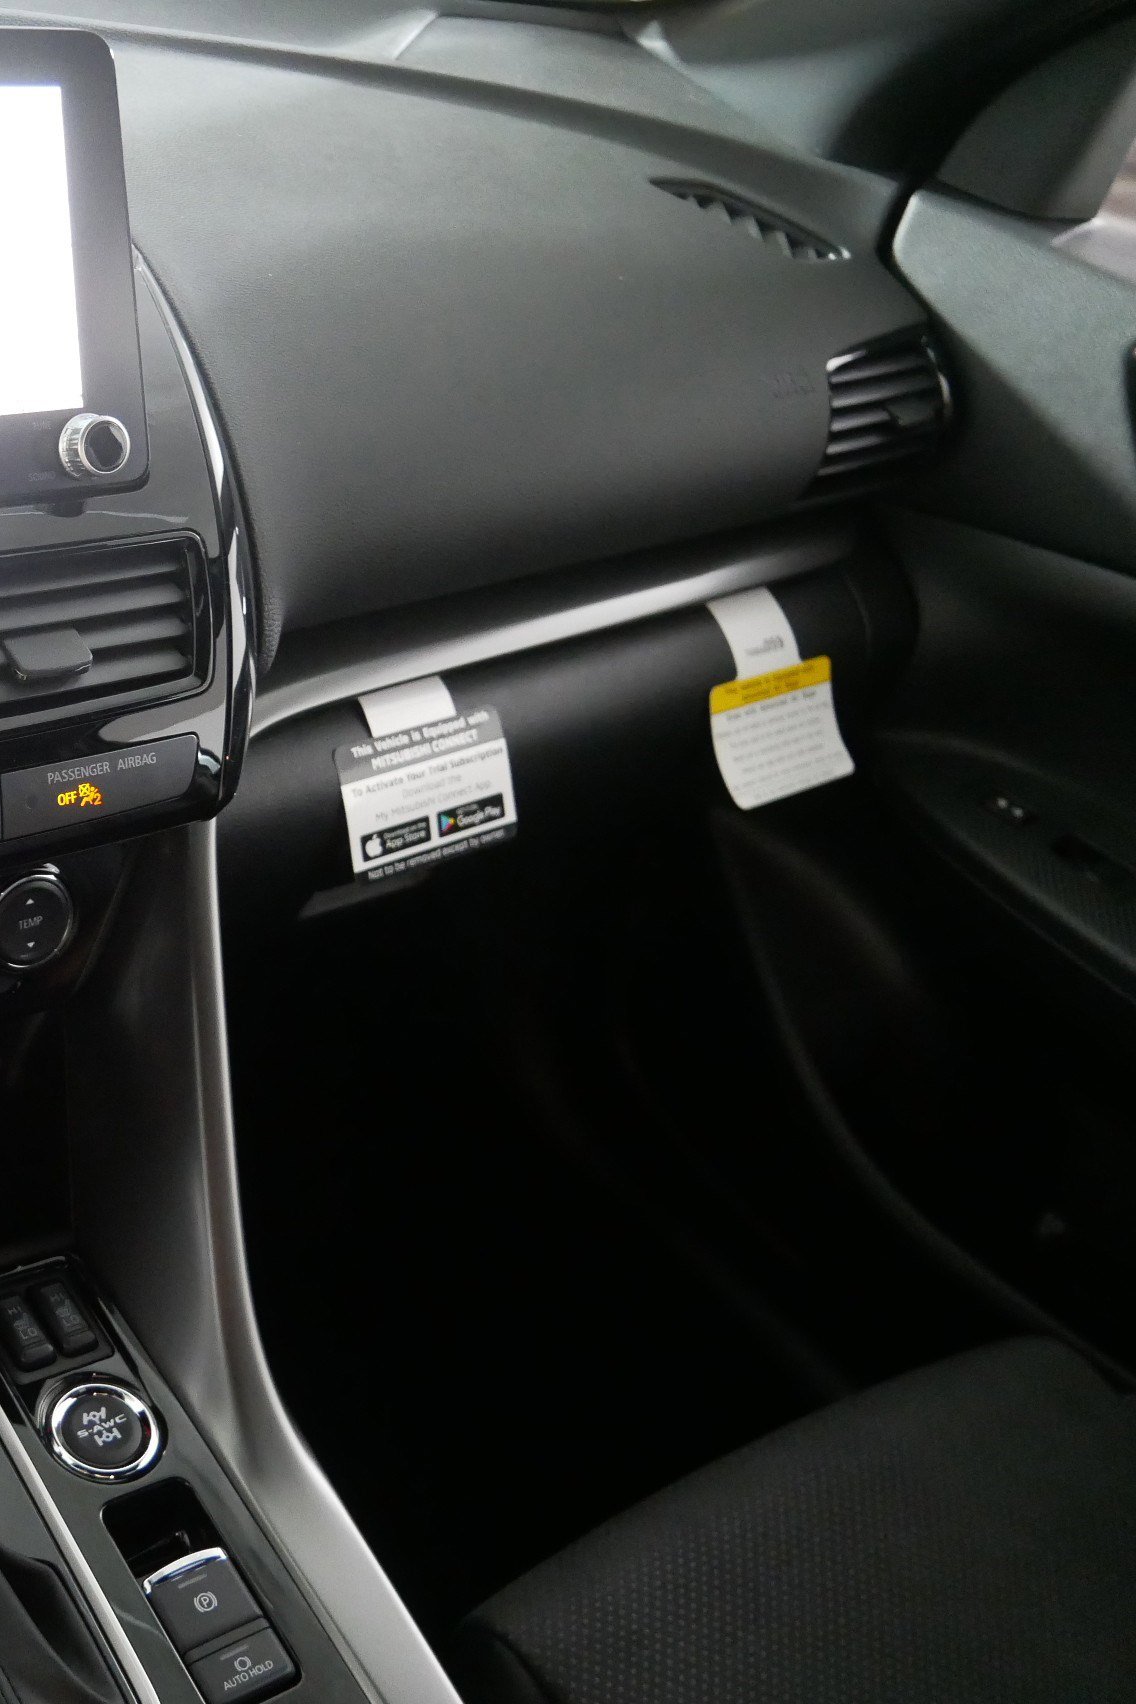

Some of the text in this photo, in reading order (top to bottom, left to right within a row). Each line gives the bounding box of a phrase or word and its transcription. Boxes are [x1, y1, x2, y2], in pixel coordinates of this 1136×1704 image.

[371, 729, 478, 771] MITSUBISHI CONNECT
[47, 752, 157, 785] PASSENGER AIRBAG
[57, 791, 77, 806] OFF
[456, 809, 484, 828] Google
[483, 804, 503, 818] Play
[385, 829, 427, 850] App Store
[18, 915, 43, 930] TEMP
[76, 1413, 128, 1439] S-AWC
[223, 1659, 274, 1691] AUTO HOLD
